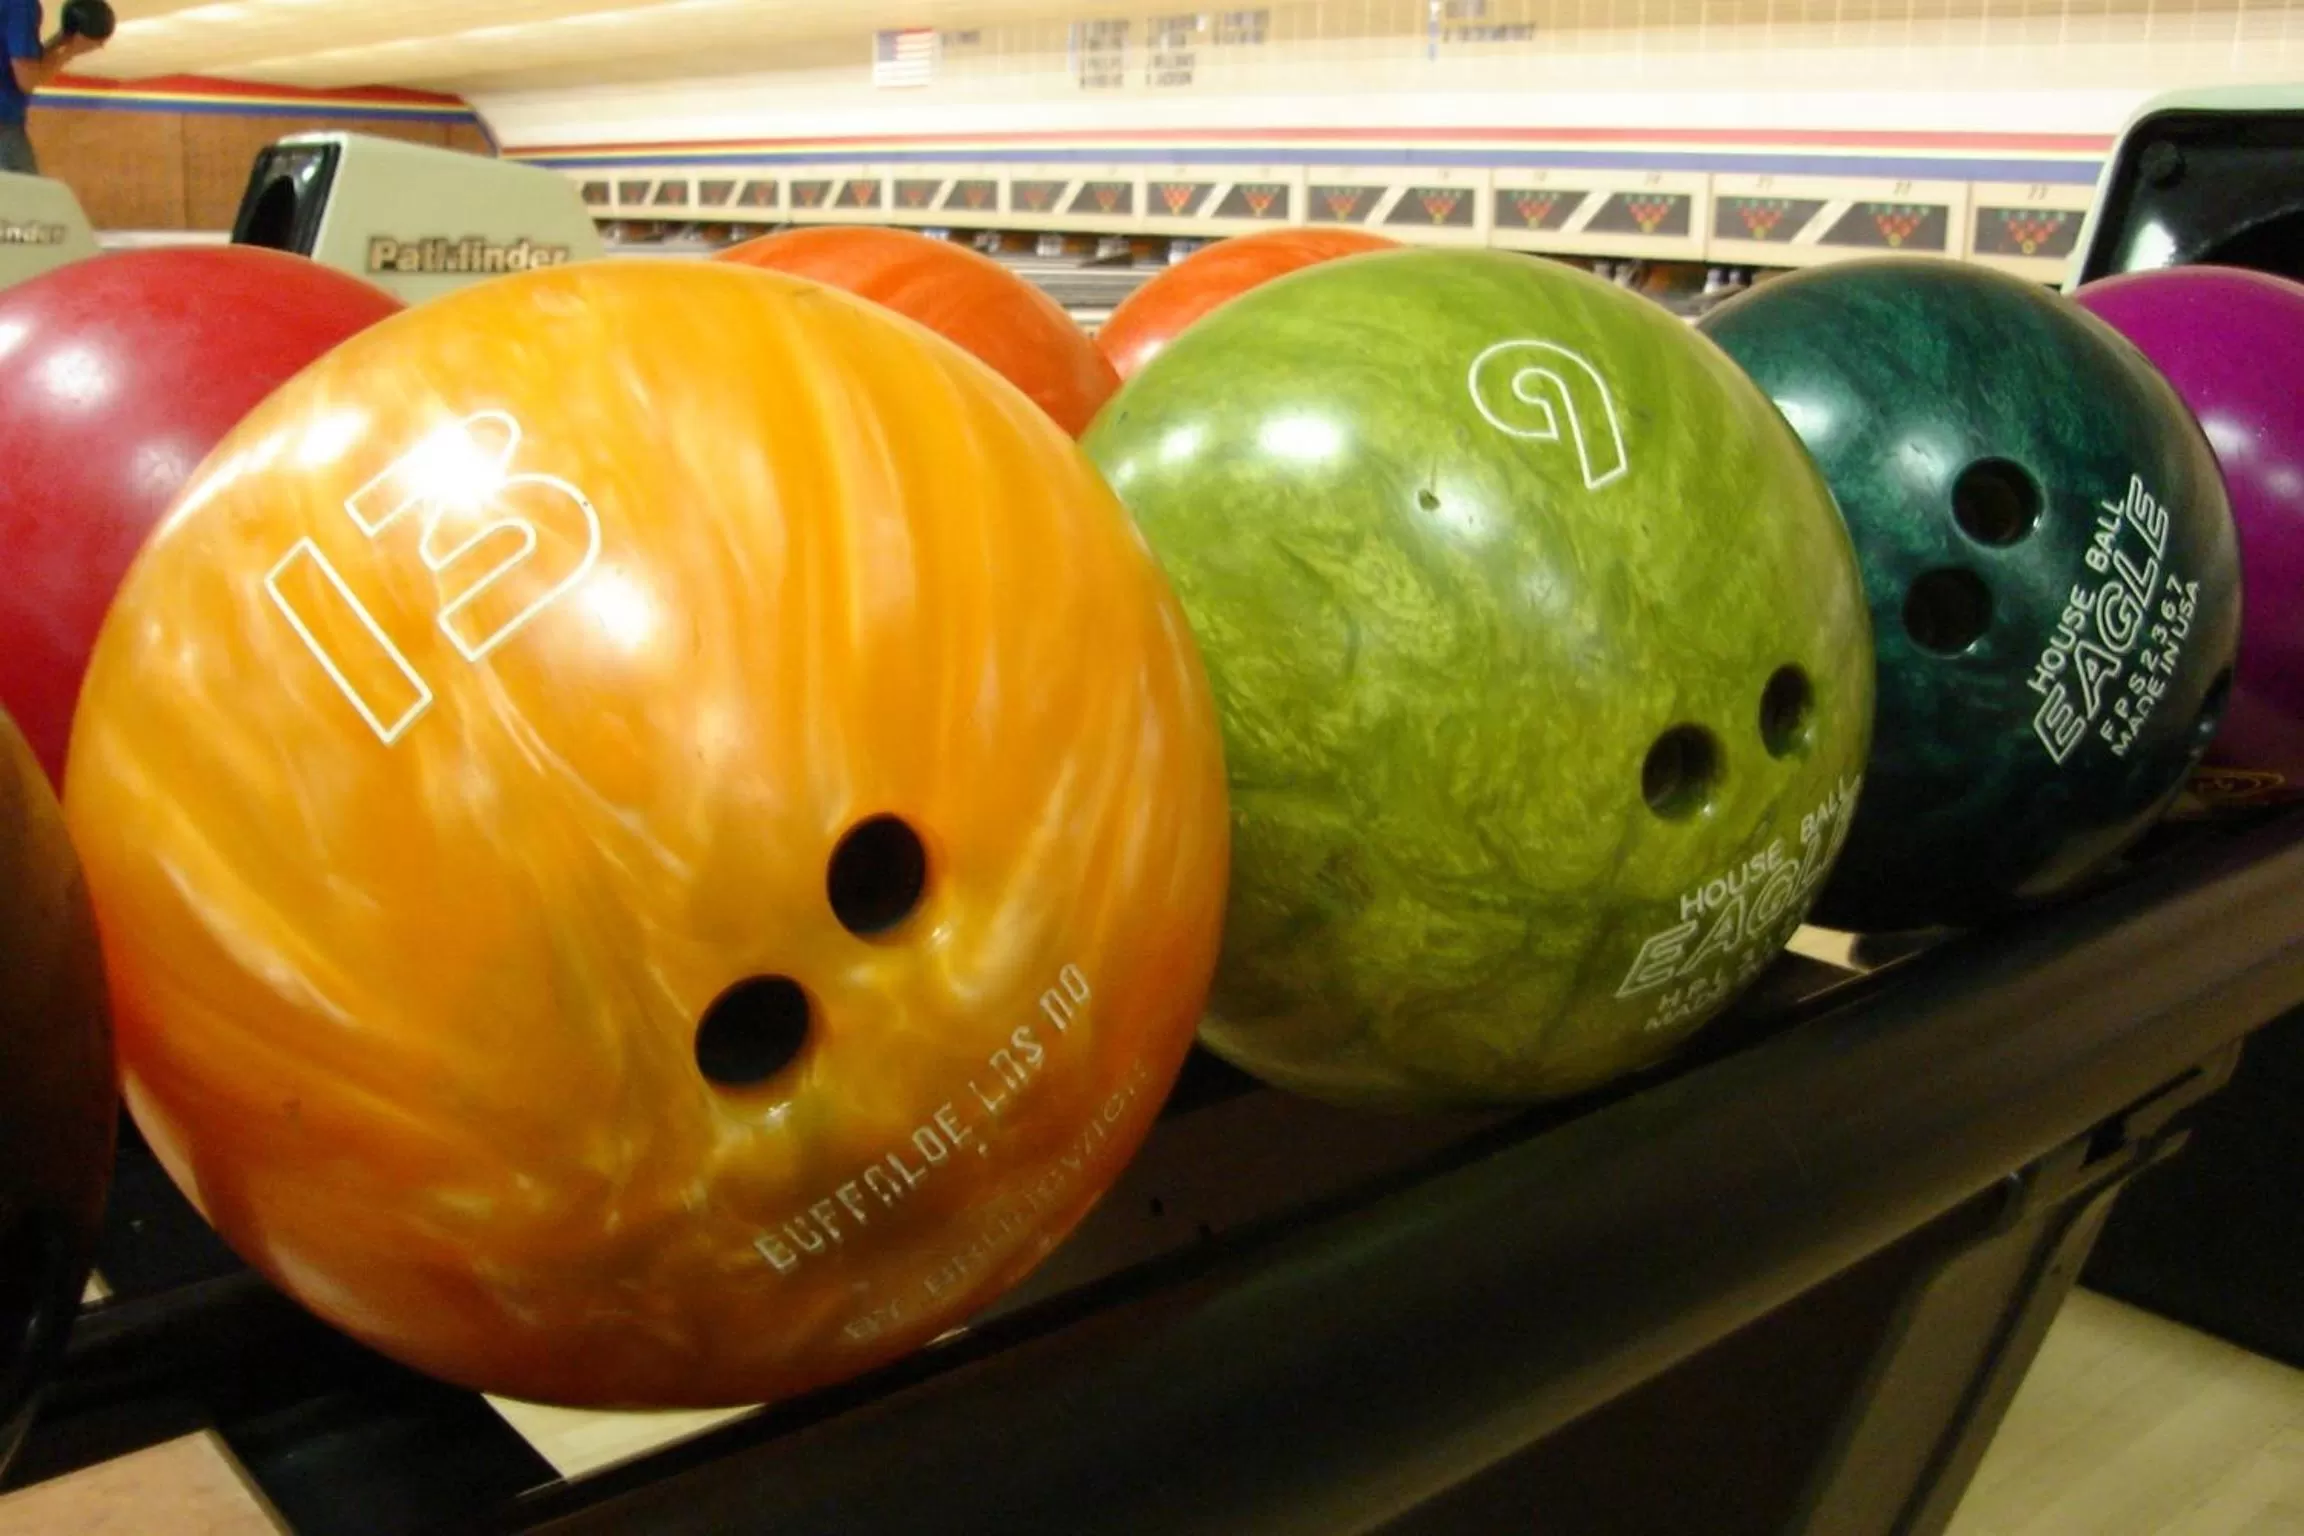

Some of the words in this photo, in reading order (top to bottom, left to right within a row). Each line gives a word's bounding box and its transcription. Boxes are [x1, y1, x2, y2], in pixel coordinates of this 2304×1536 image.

[369, 236, 568, 272] Pathfinder
[1468, 339, 1628, 490] 9
[264, 409, 602, 746] 13
[2027, 584, 2097, 695] HOUSE
[2085, 499, 2125, 574] BALL
[2033, 474, 2170, 765] EAGLE
[2111, 676, 2167, 757] MADE
[2160, 640, 2181, 676] IN
[2171, 580, 2200, 640] USA
[1680, 837, 1785, 921] HOUSE
